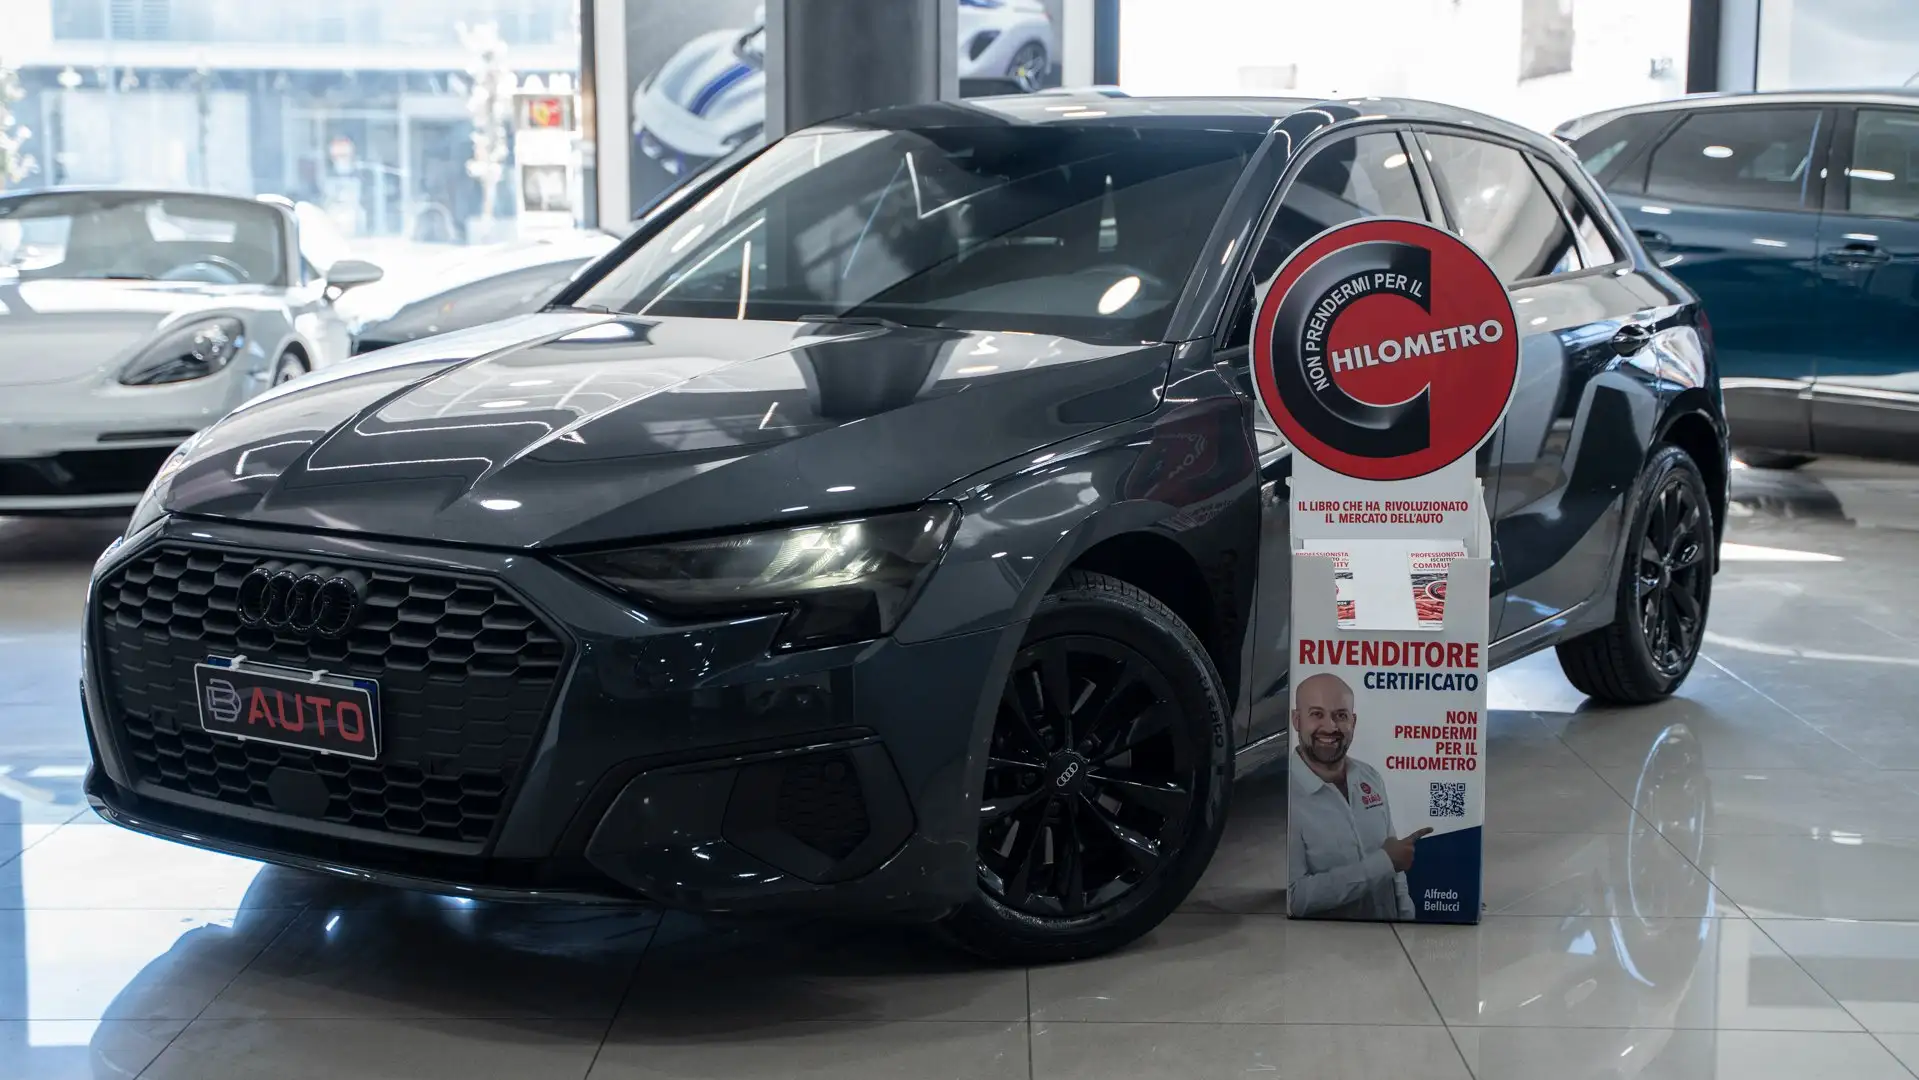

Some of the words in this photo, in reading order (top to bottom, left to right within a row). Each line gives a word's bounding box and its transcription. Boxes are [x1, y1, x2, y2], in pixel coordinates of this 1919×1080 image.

[1374, 273, 1406, 289] PER
[1409, 278, 1423, 298] IL
[1306, 276, 1370, 352] PRENDERMI
[1331, 319, 1503, 373] HILOMETRO
[1306, 356, 1330, 391] NON
[1298, 501, 1308, 511] IL
[1310, 501, 1340, 511] LIBRO
[1343, 501, 1363, 511] CHE
[1366, 501, 1380, 511] HA
[1385, 501, 1469, 512] RIVOLUZIONATO
[1325, 513, 1335, 524] IL
[1339, 513, 1388, 524] MERCATO
[1390, 513, 1443, 524] DELL'AUTO
[1299, 639, 1479, 668] RIVENDITORE
[1363, 671, 1479, 692] CERTIFICATO
[248, 686, 366, 743] AUTO
[1446, 711, 1478, 725] NON
[1394, 726, 1477, 741] PRENDERMI
[1435, 741, 1462, 756] PER
[1465, 741, 1478, 756] IL
[1386, 755, 1477, 771] CHILOMETRO
[1424, 889, 1459, 900] Alfredo
[1424, 900, 1460, 912] Bellucci
